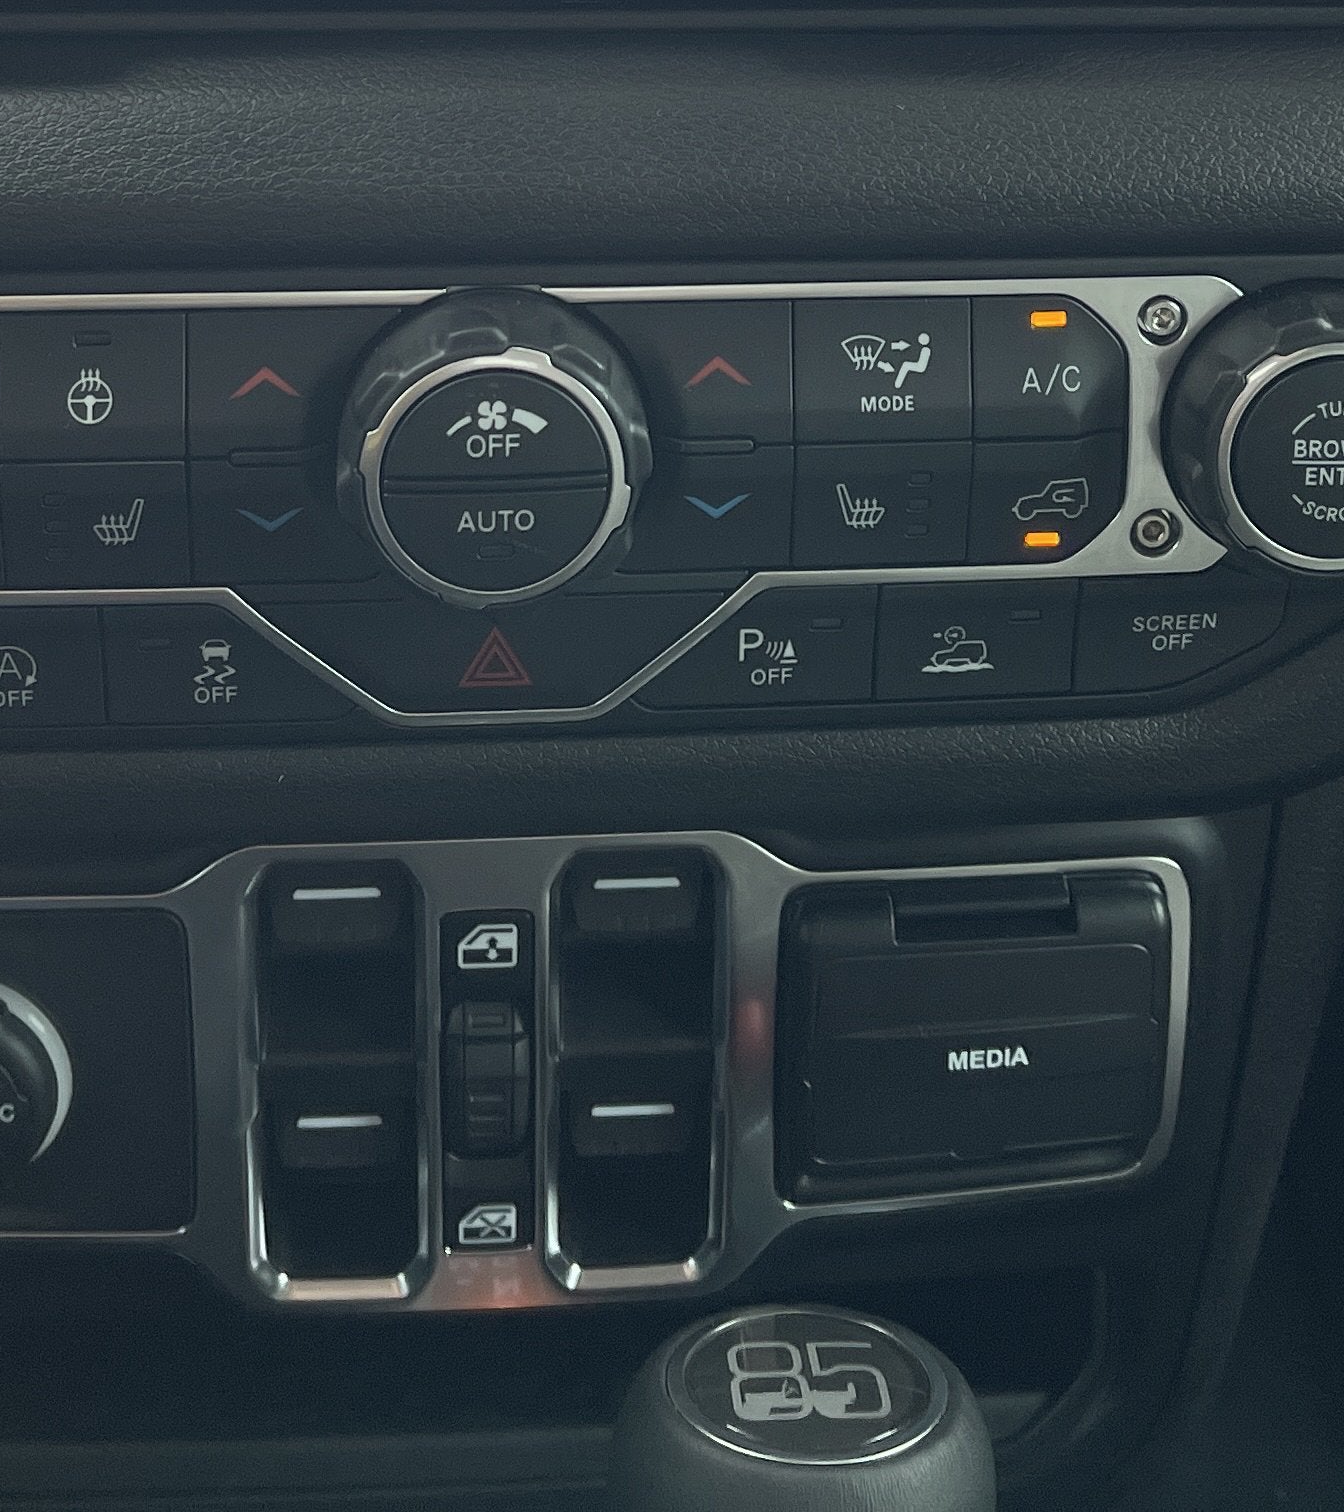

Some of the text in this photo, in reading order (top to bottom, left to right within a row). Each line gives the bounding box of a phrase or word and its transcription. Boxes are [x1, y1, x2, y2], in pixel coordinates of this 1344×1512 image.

[1022, 366, 1081, 394] A/C
[860, 395, 915, 413] MODE
[466, 433, 520, 458] OFF
[457, 509, 535, 534] AUTO
[1132, 612, 1217, 632] SCREEN
[738, 629, 765, 663] P
[1151, 632, 1193, 651] OFF
[750, 668, 793, 685] OFF
[194, 686, 237, 703] OFF
[947, 1045, 1029, 1071] MEDIA
[726, 1342, 892, 1420] 85
